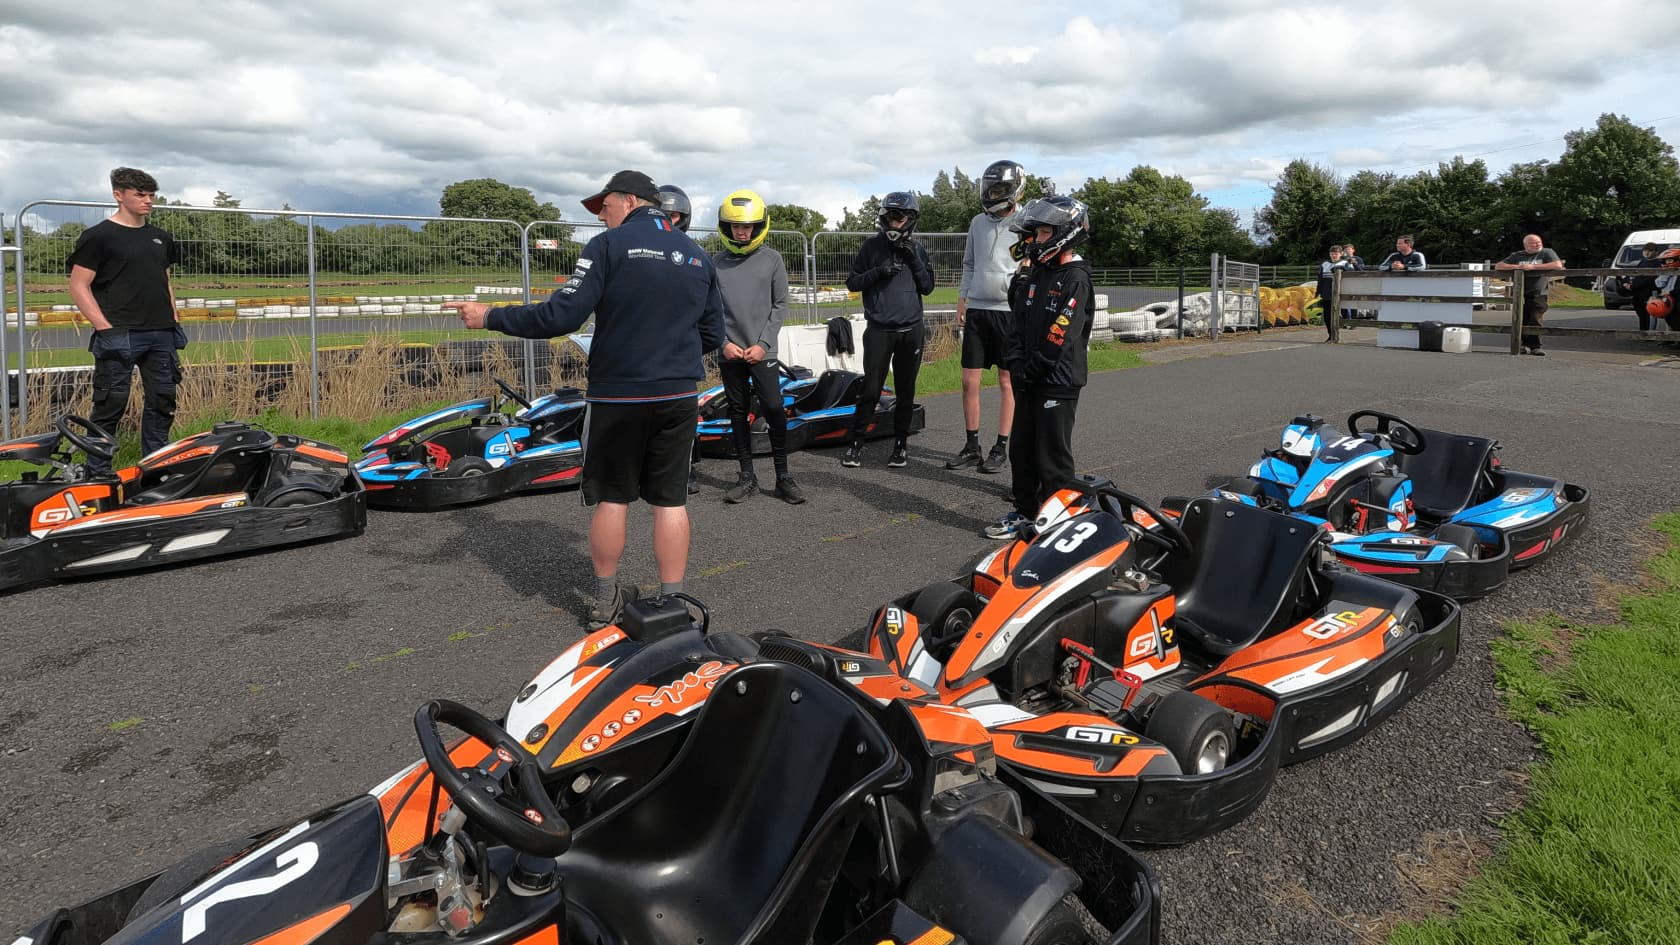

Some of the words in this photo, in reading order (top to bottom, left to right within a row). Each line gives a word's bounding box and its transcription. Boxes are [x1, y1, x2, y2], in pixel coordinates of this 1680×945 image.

[1328, 436, 1367, 451] 14
[1040, 520, 1098, 553] 13
[887, 607, 902, 636] GTR
[1302, 611, 1364, 640] GTR
[1065, 726, 1140, 745] GTR
